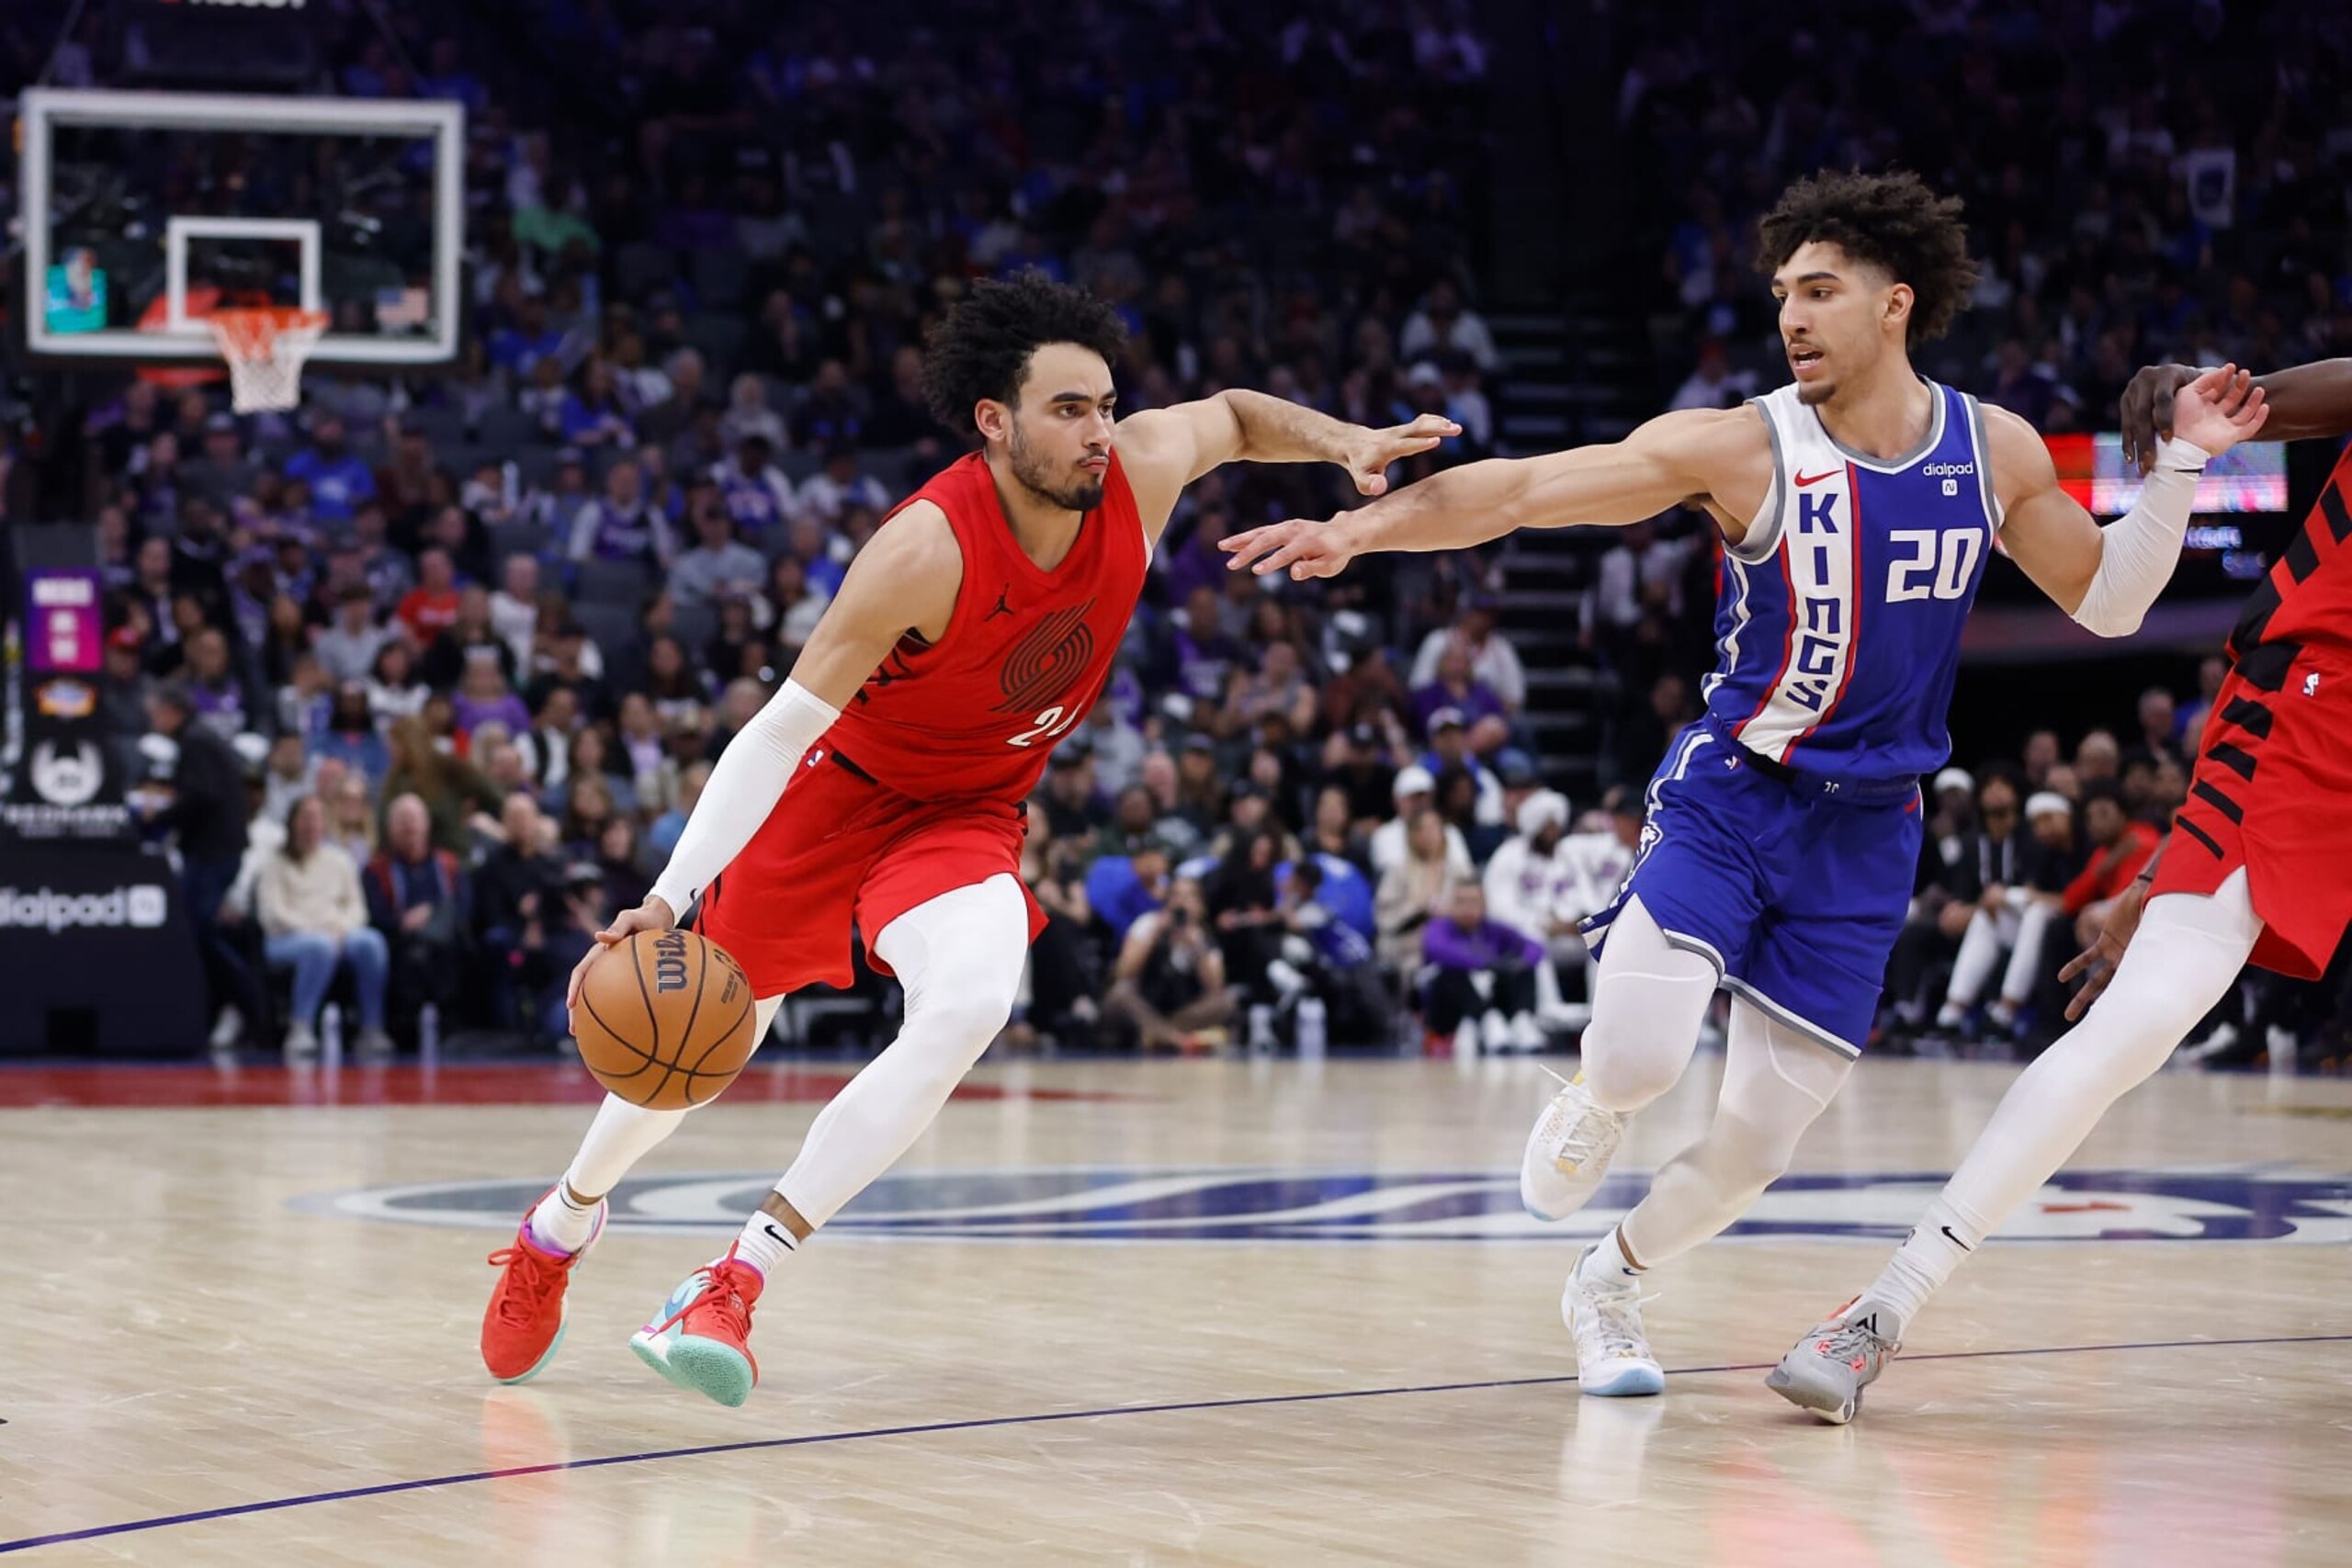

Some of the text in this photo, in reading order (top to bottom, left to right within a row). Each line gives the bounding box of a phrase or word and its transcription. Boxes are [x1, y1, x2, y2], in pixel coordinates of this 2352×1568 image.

[1923, 461, 1973, 478] dialpad
[1886, 527, 1983, 604] 20
[1785, 493, 1840, 713] KINGS
[653, 929, 687, 994] Wils
